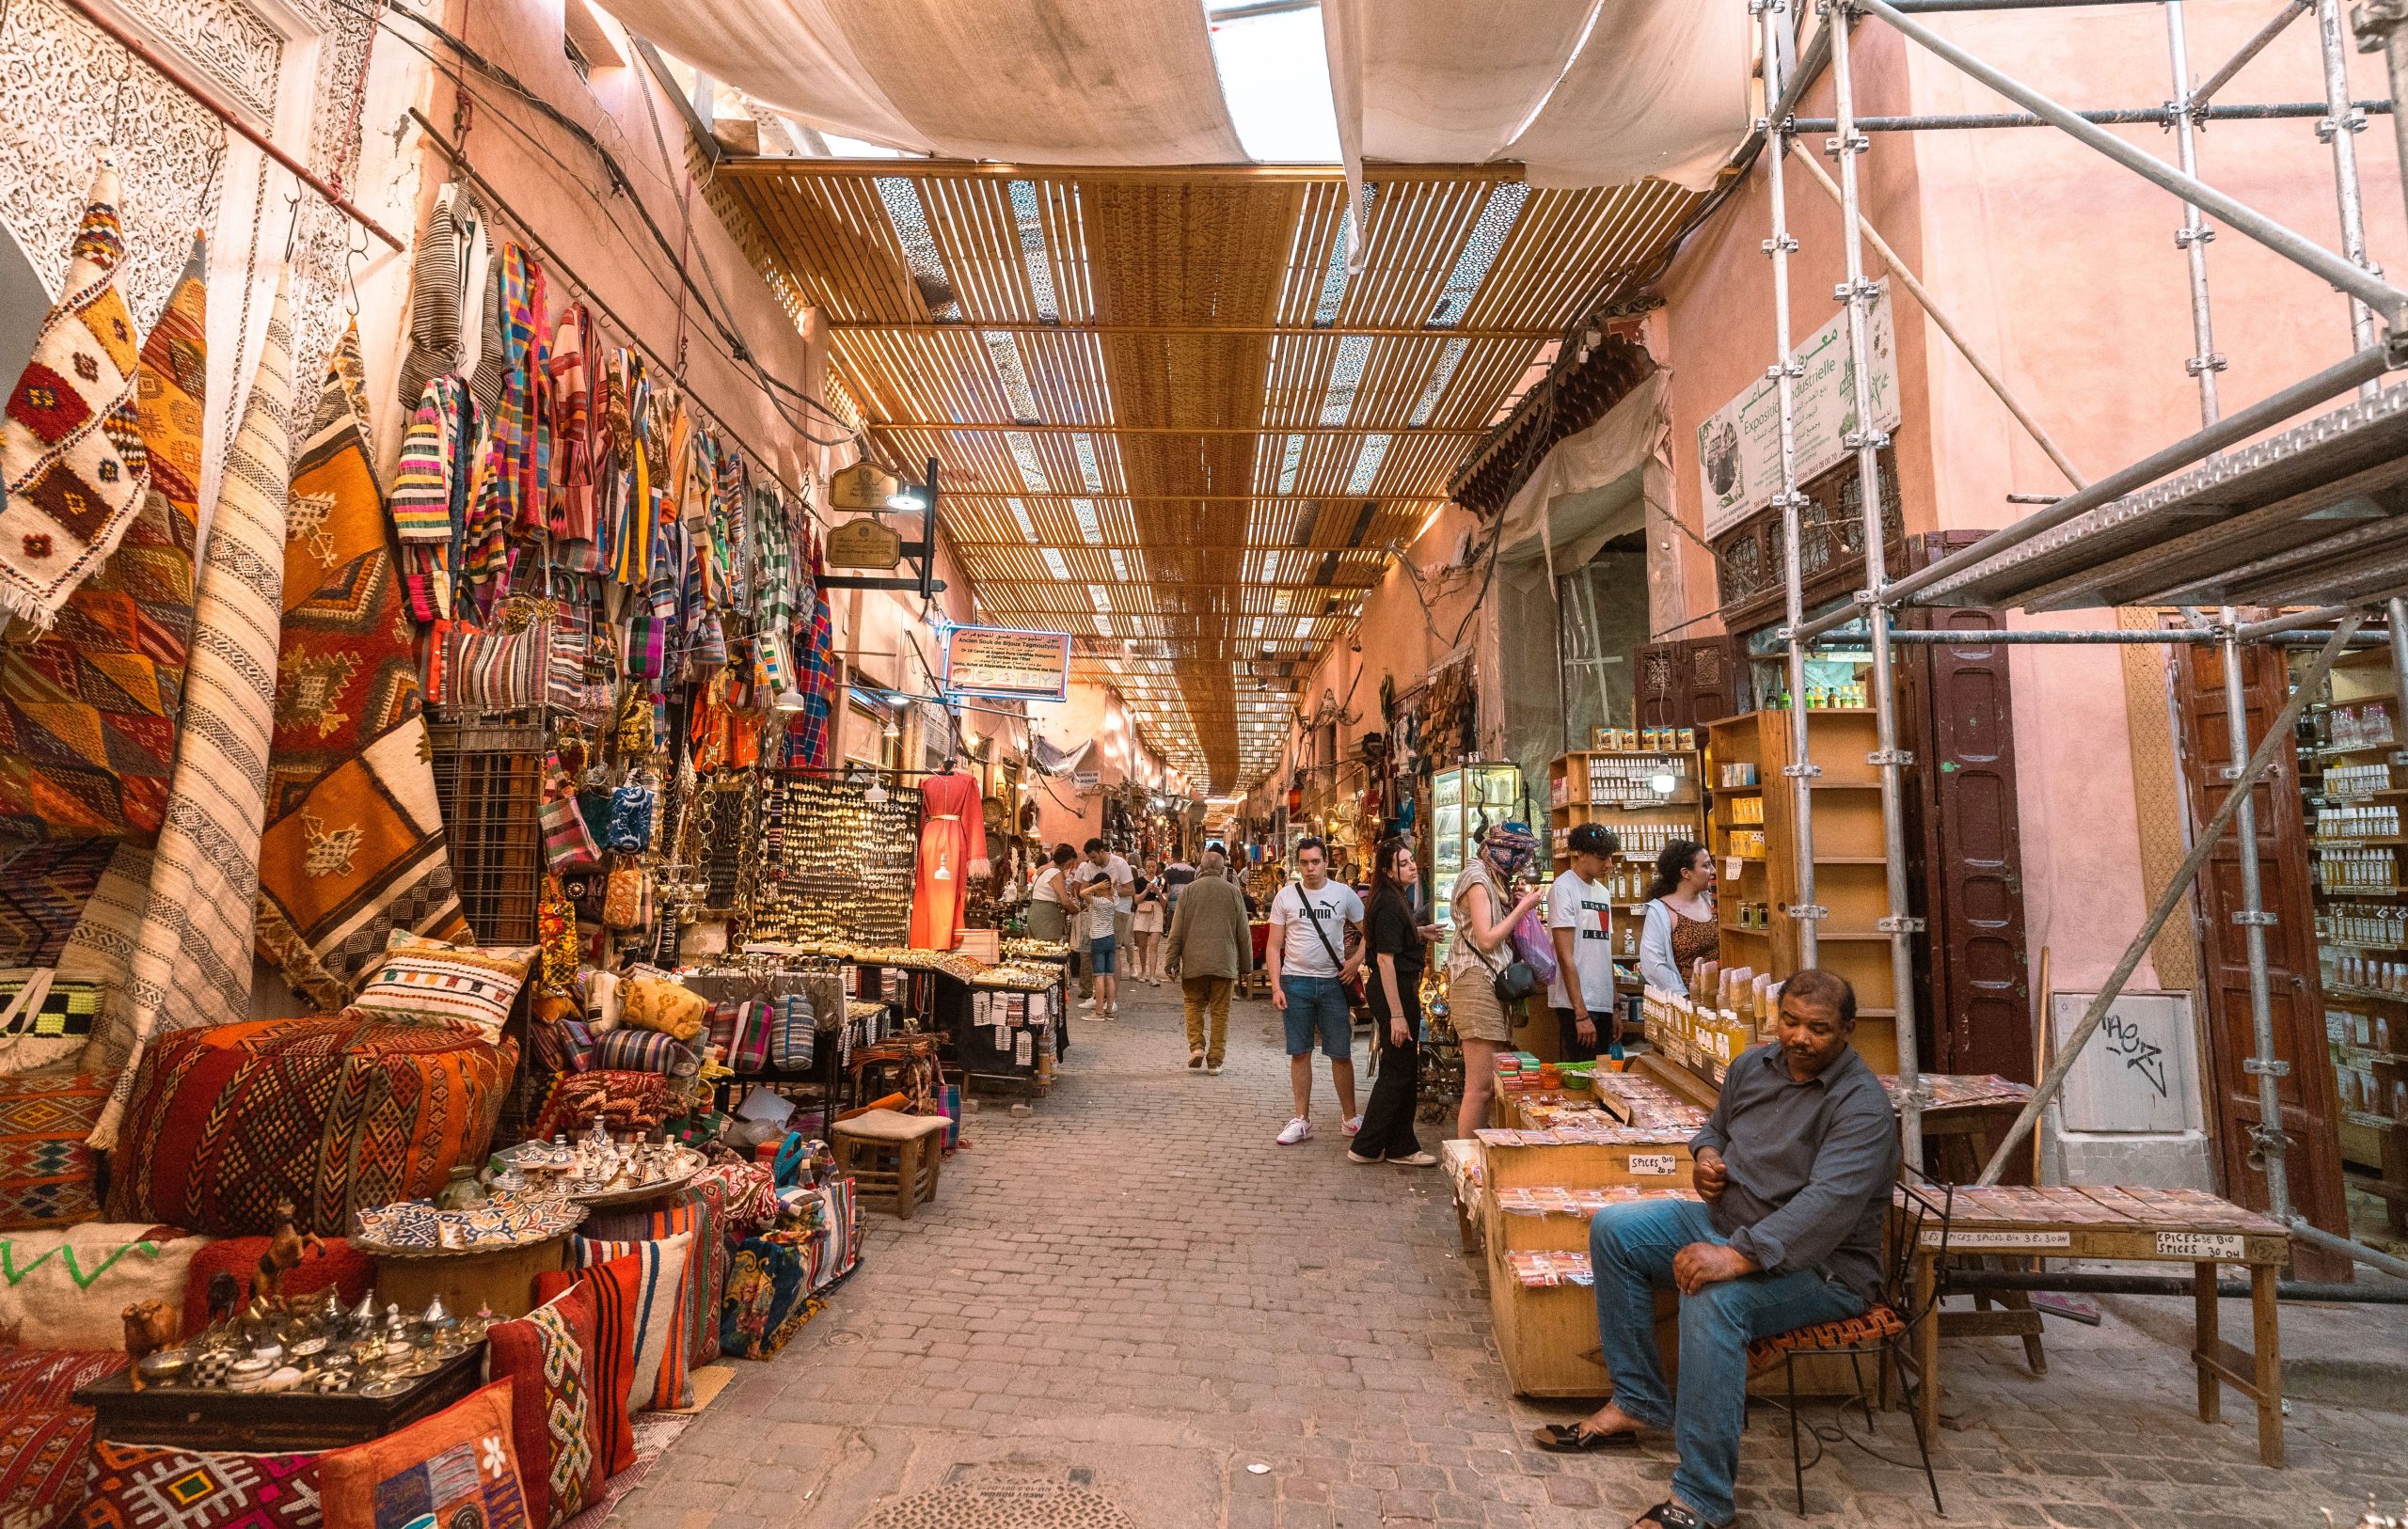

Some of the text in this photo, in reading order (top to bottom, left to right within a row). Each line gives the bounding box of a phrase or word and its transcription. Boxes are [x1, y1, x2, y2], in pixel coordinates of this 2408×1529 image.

[1744, 402, 1779, 434] Expositio
[1791, 359, 1835, 400] ndustrielle
[1632, 1158, 1658, 1167] SPICES
[1948, 1233, 1973, 1241] PICES.
[2158, 1244, 2196, 1253] SPICES
[2208, 1247, 2220, 1257] 30
